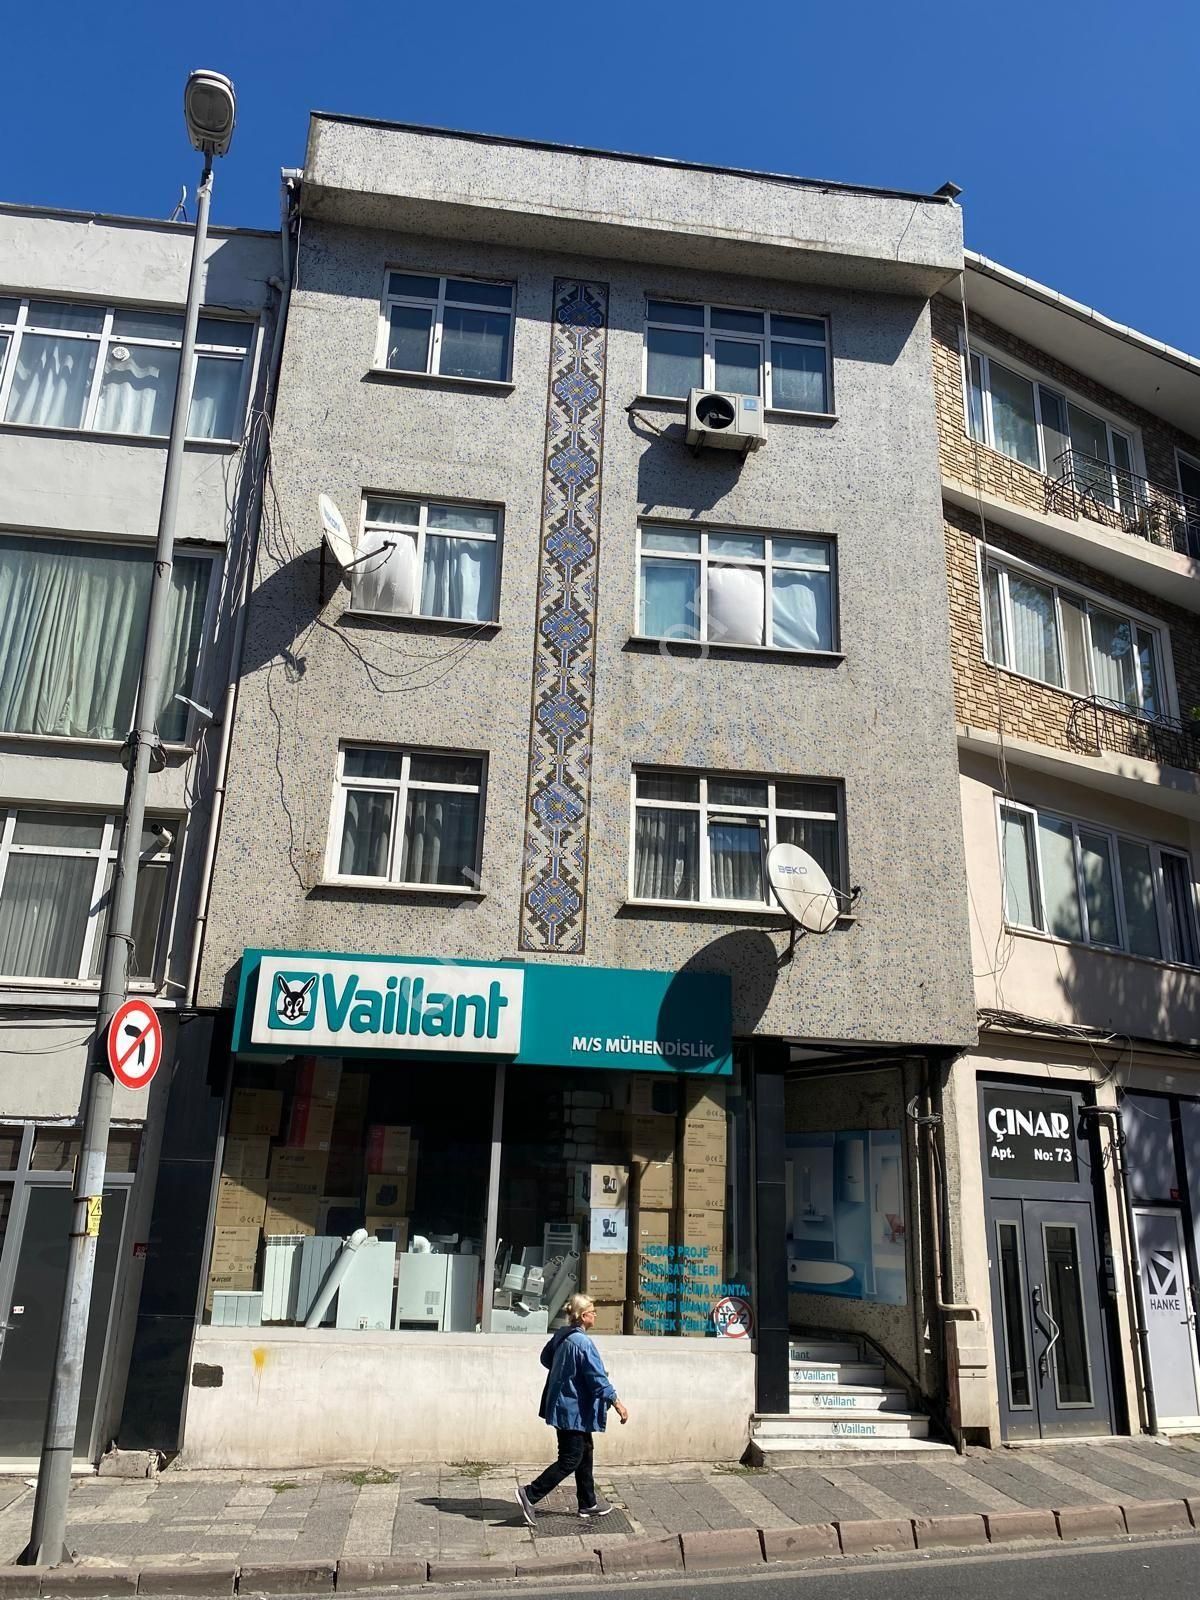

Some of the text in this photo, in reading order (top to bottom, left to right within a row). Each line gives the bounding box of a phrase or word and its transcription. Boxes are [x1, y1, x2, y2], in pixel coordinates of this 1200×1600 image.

[777, 864, 808, 875] BEKO
[322, 973, 509, 1039] Vaillant
[572, 1035, 715, 1058] M/S MÜHENDİSLİK
[988, 1107, 1070, 1142] ÇINAR
[991, 1146, 1073, 1162] Apt. No: 73
[678, 1246, 709, 1259] PROJE
[1150, 1298, 1181, 1311] HANKE
[802, 1370, 836, 1381] Vaillant
[822, 1395, 856, 1407] Vaillant
[841, 1423, 876, 1434] Vaillant
